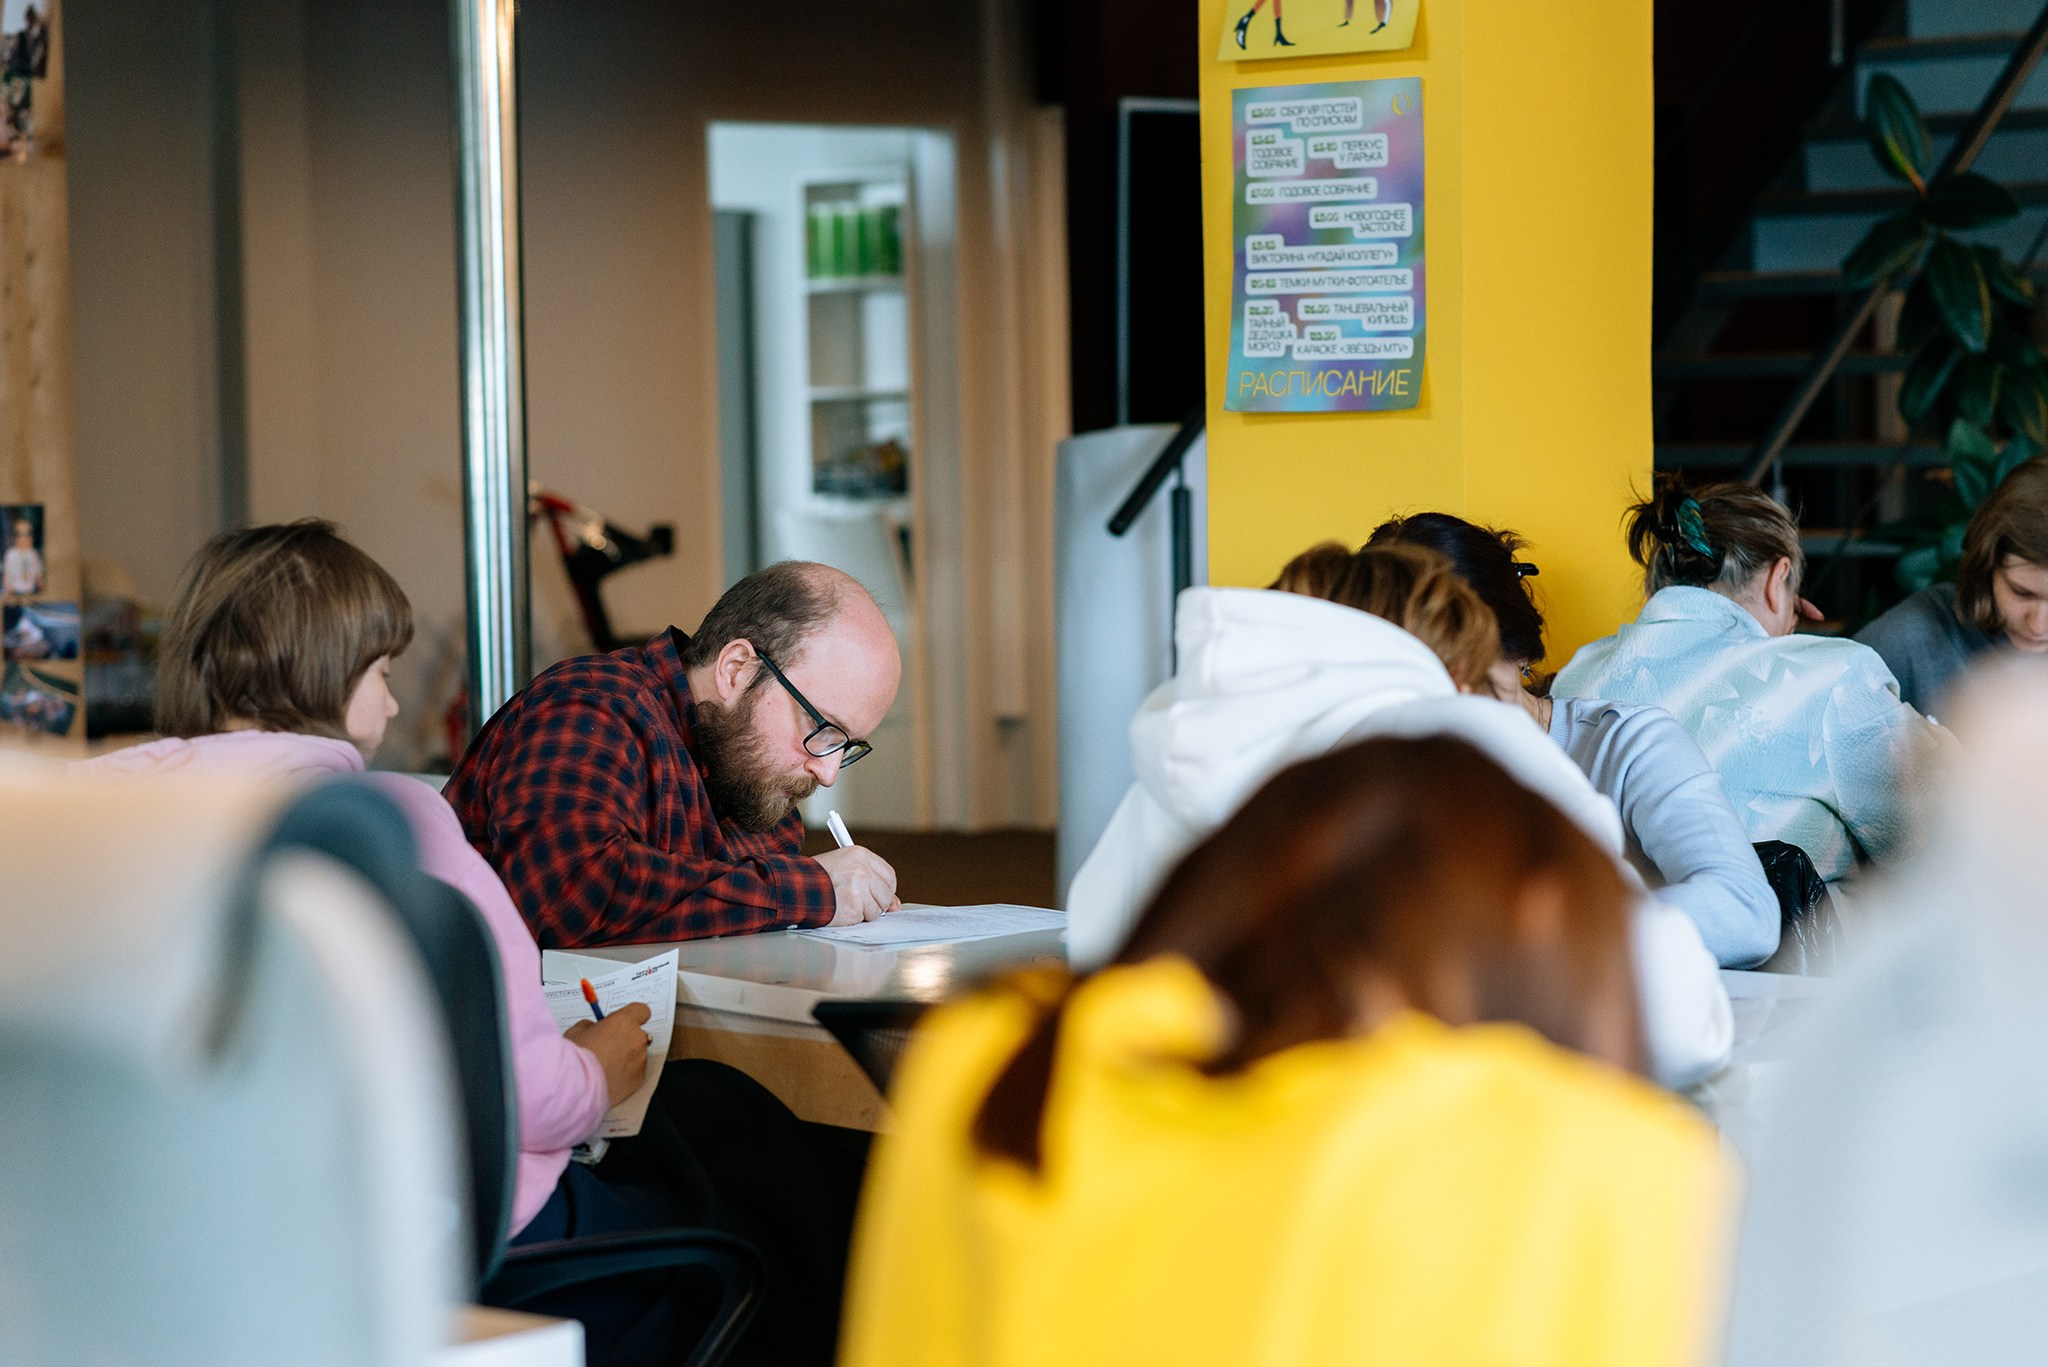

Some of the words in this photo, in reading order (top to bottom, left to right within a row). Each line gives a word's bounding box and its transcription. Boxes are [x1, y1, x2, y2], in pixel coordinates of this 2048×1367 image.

[1321, 101, 1357, 114] ГОСТЕЙ
[1296, 117, 1310, 127] ПО
[1342, 139, 1383, 151] ПЕРЕКУС
[1252, 147, 1293, 159] ГОДОВОЕ
[1252, 158, 1299, 170] СОБРАНИЕ
[1279, 185, 1321, 197] ГОДОВОЕ
[1322, 183, 1370, 195] СОБРАНИЕ
[1344, 209, 1406, 222] НОВОГОДНЕЕ
[1359, 221, 1406, 233] ЗАСТОЛЬЕ
[1252, 254, 1305, 265] ВИКТОРИНА
[1334, 301, 1408, 315] ТАНЦЕВАЛЬНЫЙ
[1249, 317, 1286, 329] ТАЙНЫЙ
[1248, 330, 1293, 341] ДЕДУШКА
[1248, 342, 1281, 351] МОРОЗ
[1297, 344, 1337, 354] КАРАОКЕ
[1239, 369, 1411, 397] РАСПИСАНИЕ
